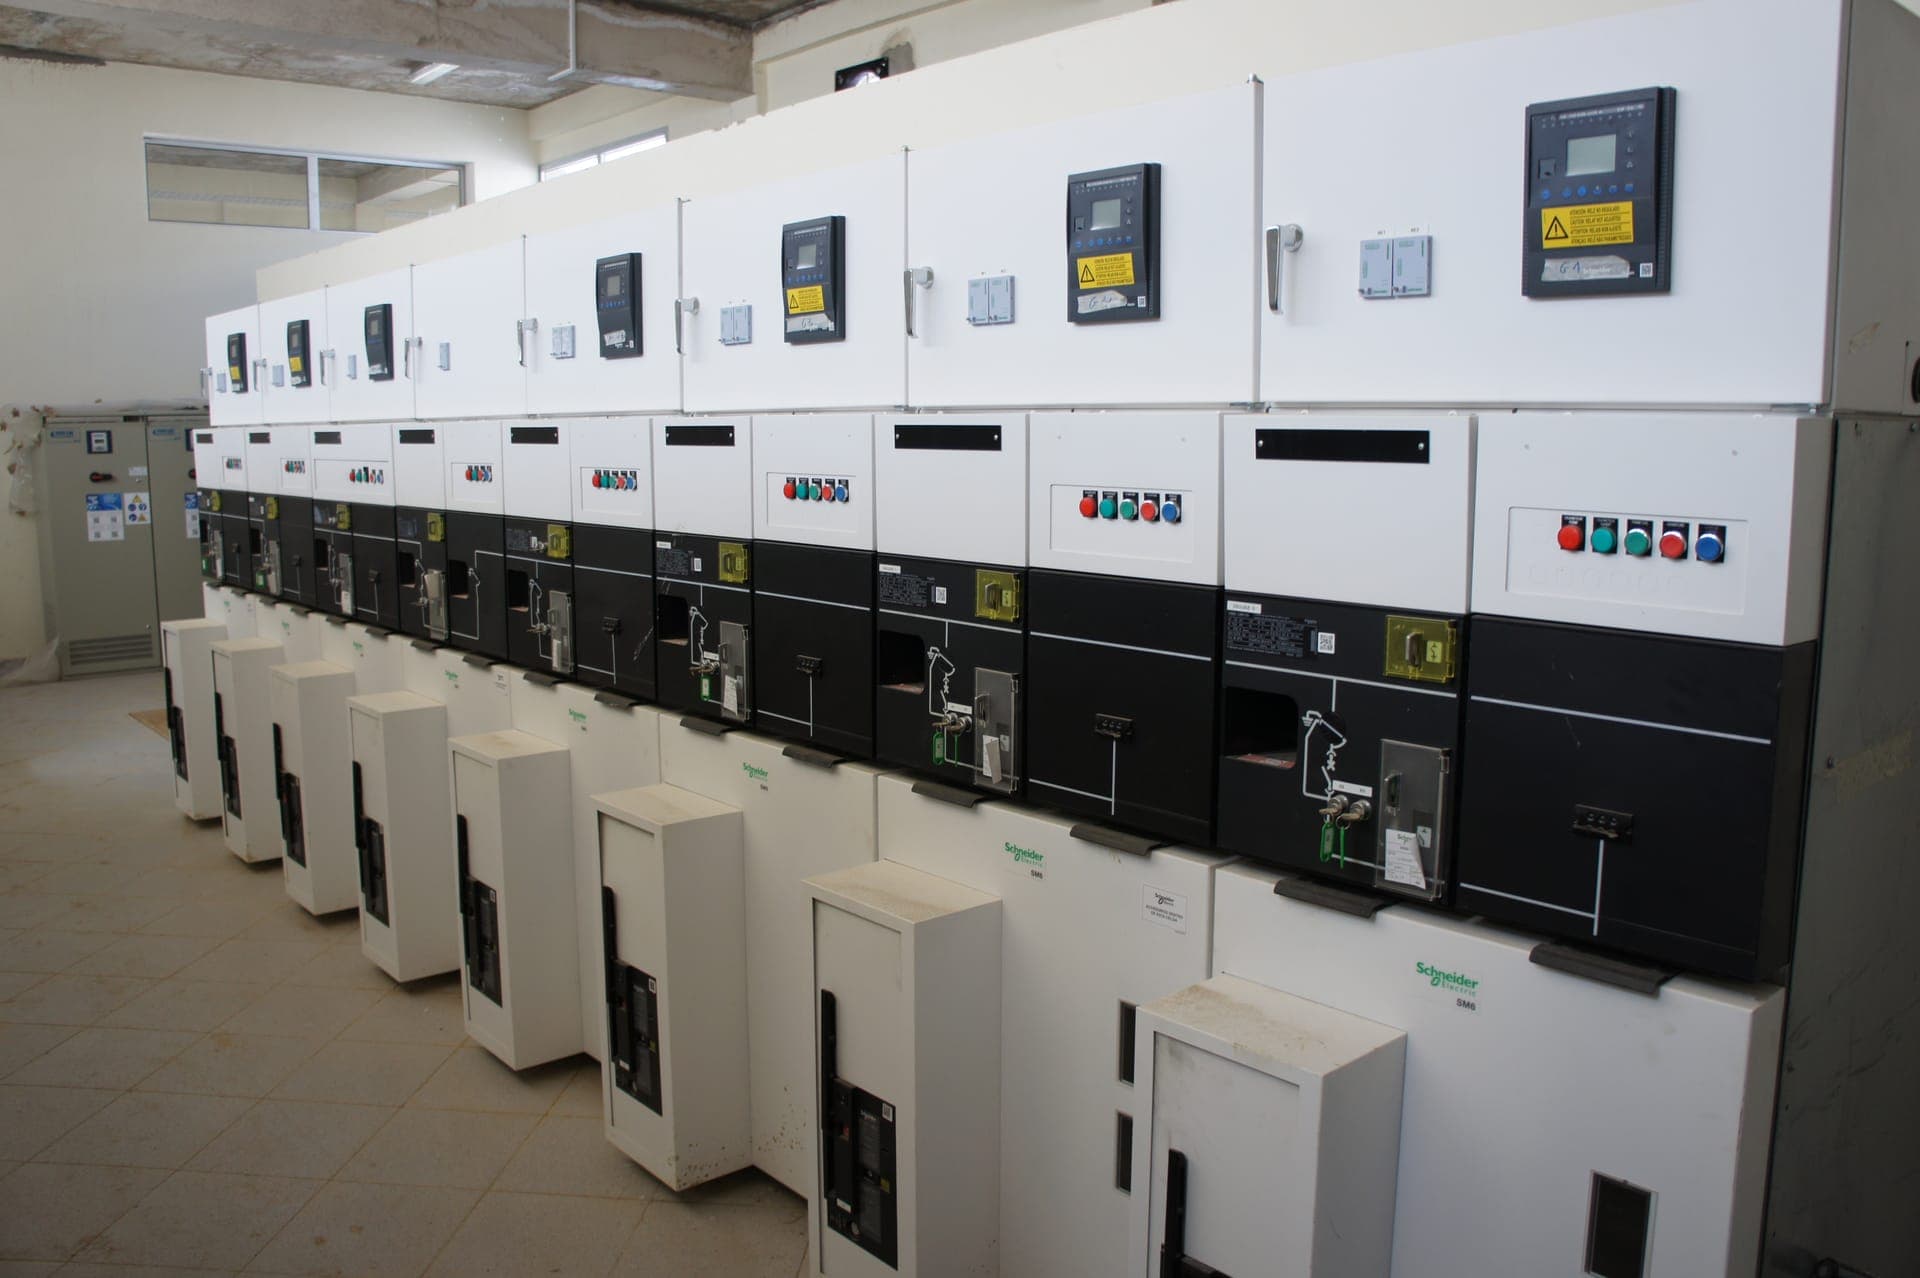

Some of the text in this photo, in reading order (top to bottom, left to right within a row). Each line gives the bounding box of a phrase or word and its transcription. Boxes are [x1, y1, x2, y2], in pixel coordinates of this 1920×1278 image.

[1004, 841, 1044, 861] Schneider
[1416, 961, 1478, 989] Schneider
[1456, 998, 1477, 1011] SM6
